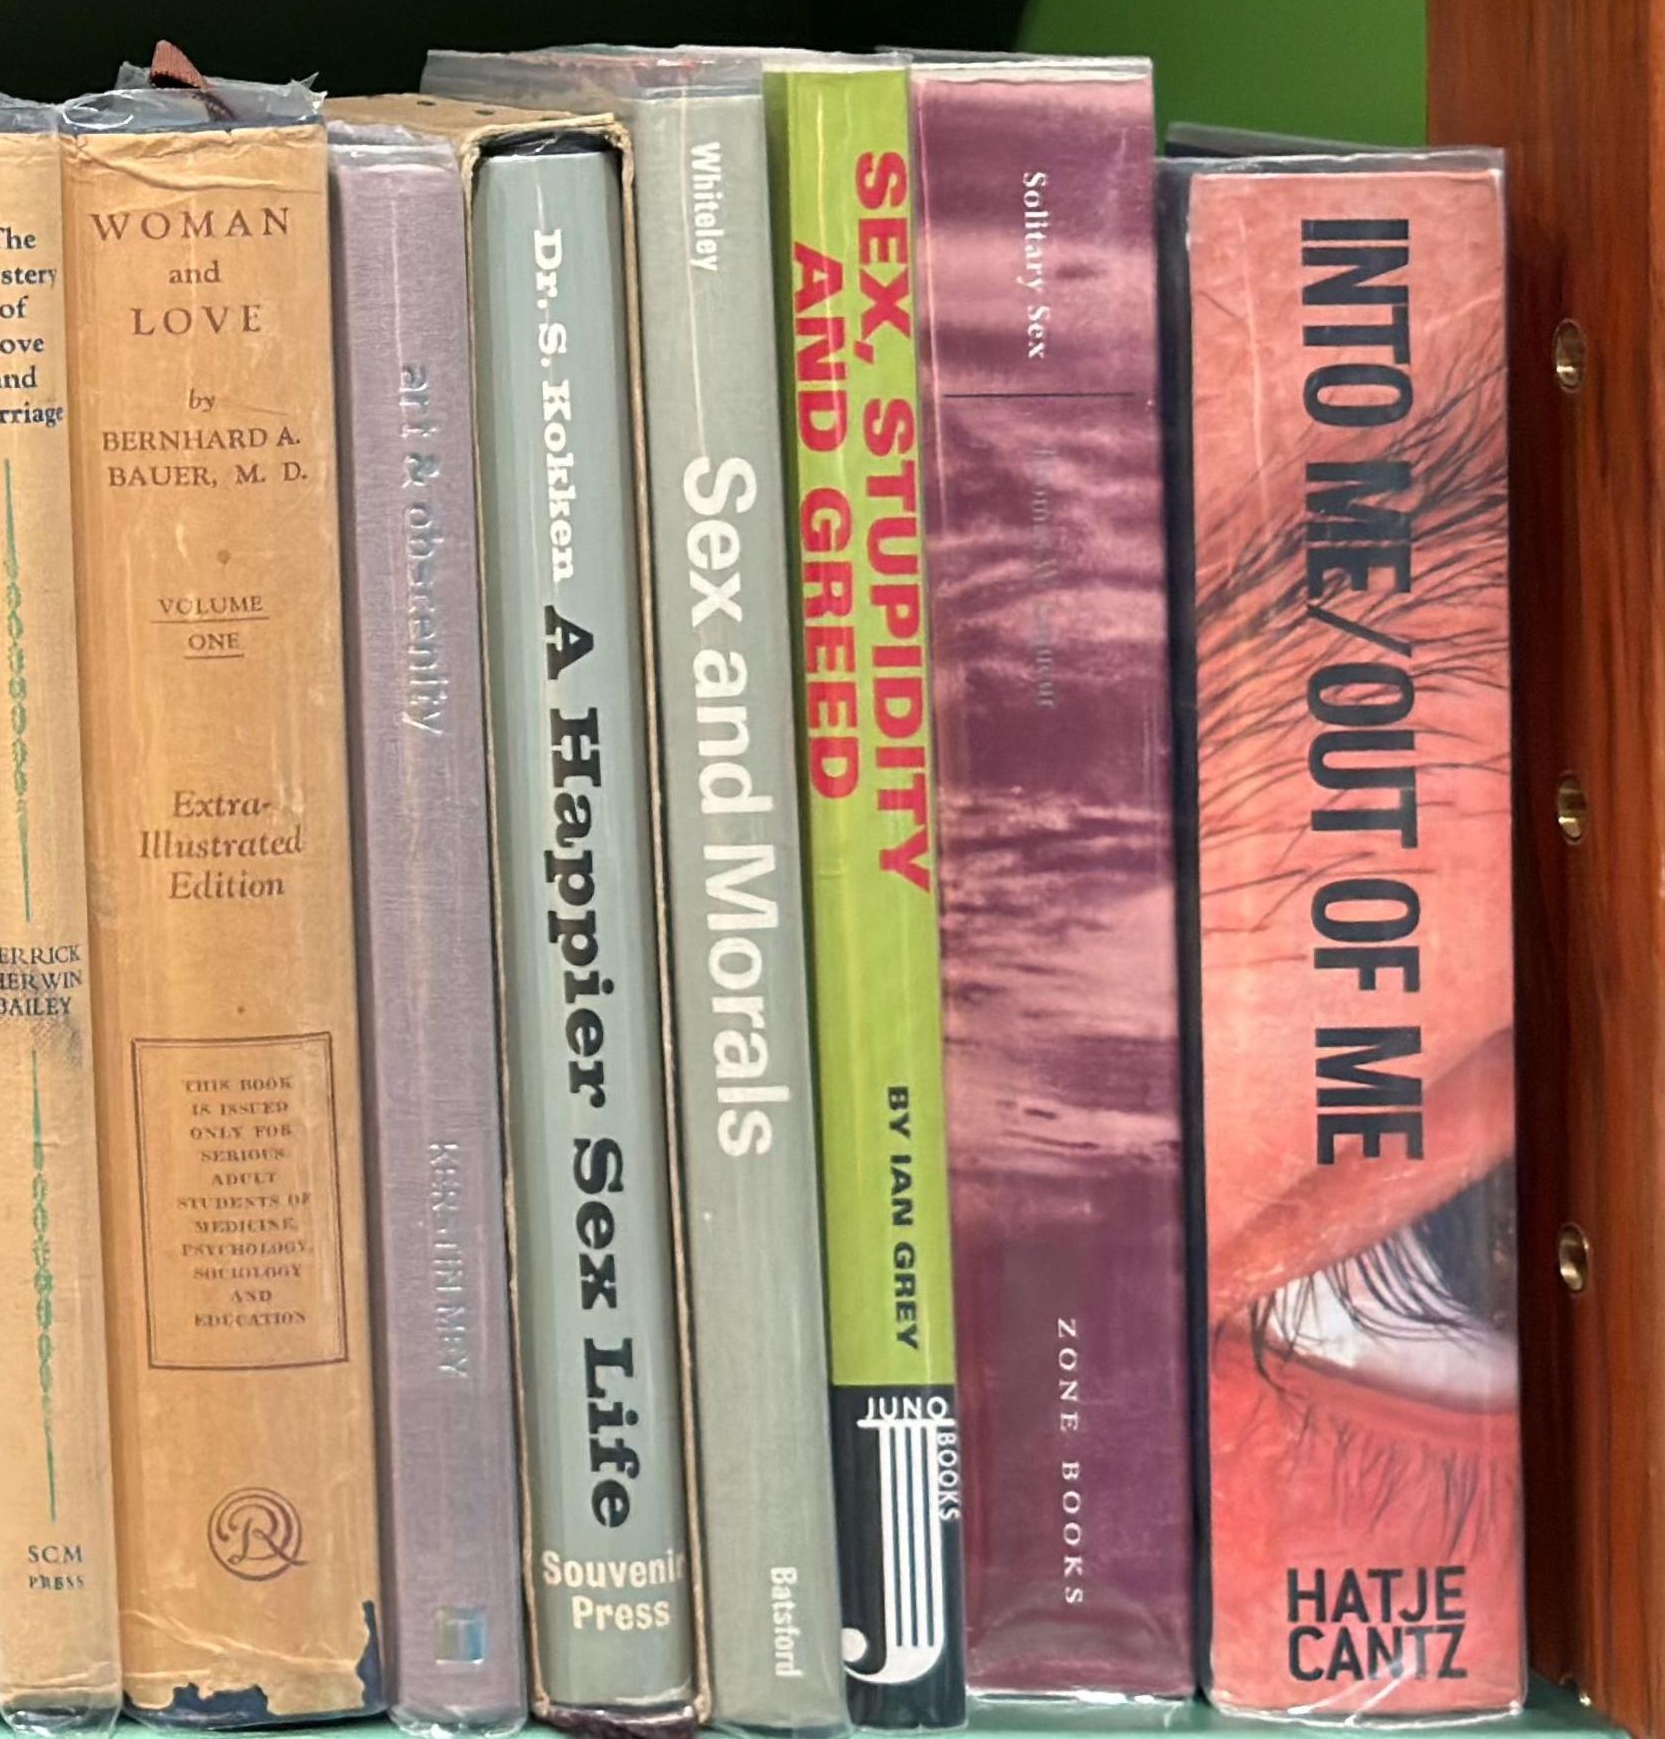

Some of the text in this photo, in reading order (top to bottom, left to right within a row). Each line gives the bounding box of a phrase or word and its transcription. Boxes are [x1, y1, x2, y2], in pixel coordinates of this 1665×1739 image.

[90, 206, 292, 242] WOMAN
[689, 140, 725, 273] Whiteley
[1015, 170, 1050, 361] Solitary Sex
[131, 303, 264, 337] LOVE
[168, 261, 221, 285] and
[792, 241, 861, 800] AND GREED
[853, 151, 932, 894] SEX, STUPIDITY
[1300, 217, 1424, 1165] INTO OF ME
[138, 828, 304, 859] Illustrated
[171, 790, 272, 819] Extra-
[682, 456, 793, 1157] Sex and Morals
[169, 870, 285, 900] Edition
[533, 228, 641, 1528] Dr. S. Kokken A Happier Sex Life
[886, 1086, 921, 1352] BY IAN GREY
[1056, 1317, 1085, 1606] ZONE BOOKS
[770, 1565, 803, 1678] Batsford
[1286, 1565, 1468, 1623] HATJE
[1287, 1624, 1469, 1682] CANTZ
